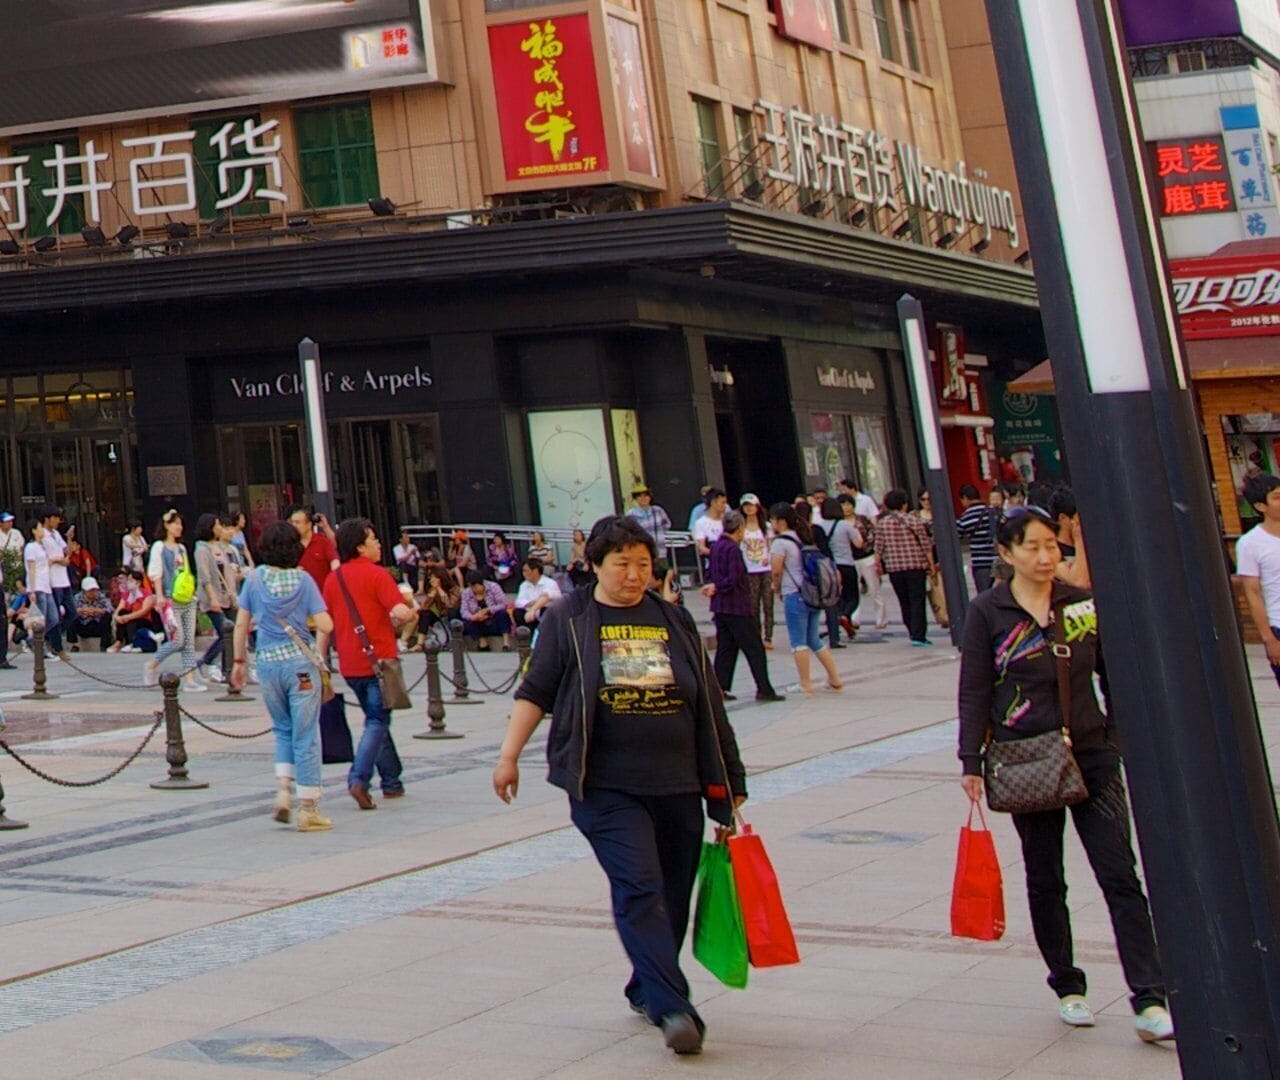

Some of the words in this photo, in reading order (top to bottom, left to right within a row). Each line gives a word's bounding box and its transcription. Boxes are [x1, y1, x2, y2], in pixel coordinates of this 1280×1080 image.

[582, 156, 597, 171] 7F
[755, 99, 898, 212] 王府井百货
[895, 139, 1020, 248] Wangfujing
[1157, 142, 1223, 177] 灵芝
[1163, 181, 1231, 215] 鹿茸
[231, 377, 270, 398] Van
[276, 371, 335, 396] Clf
[340, 375, 356, 392] &
[362, 365, 433, 396] Arpels
